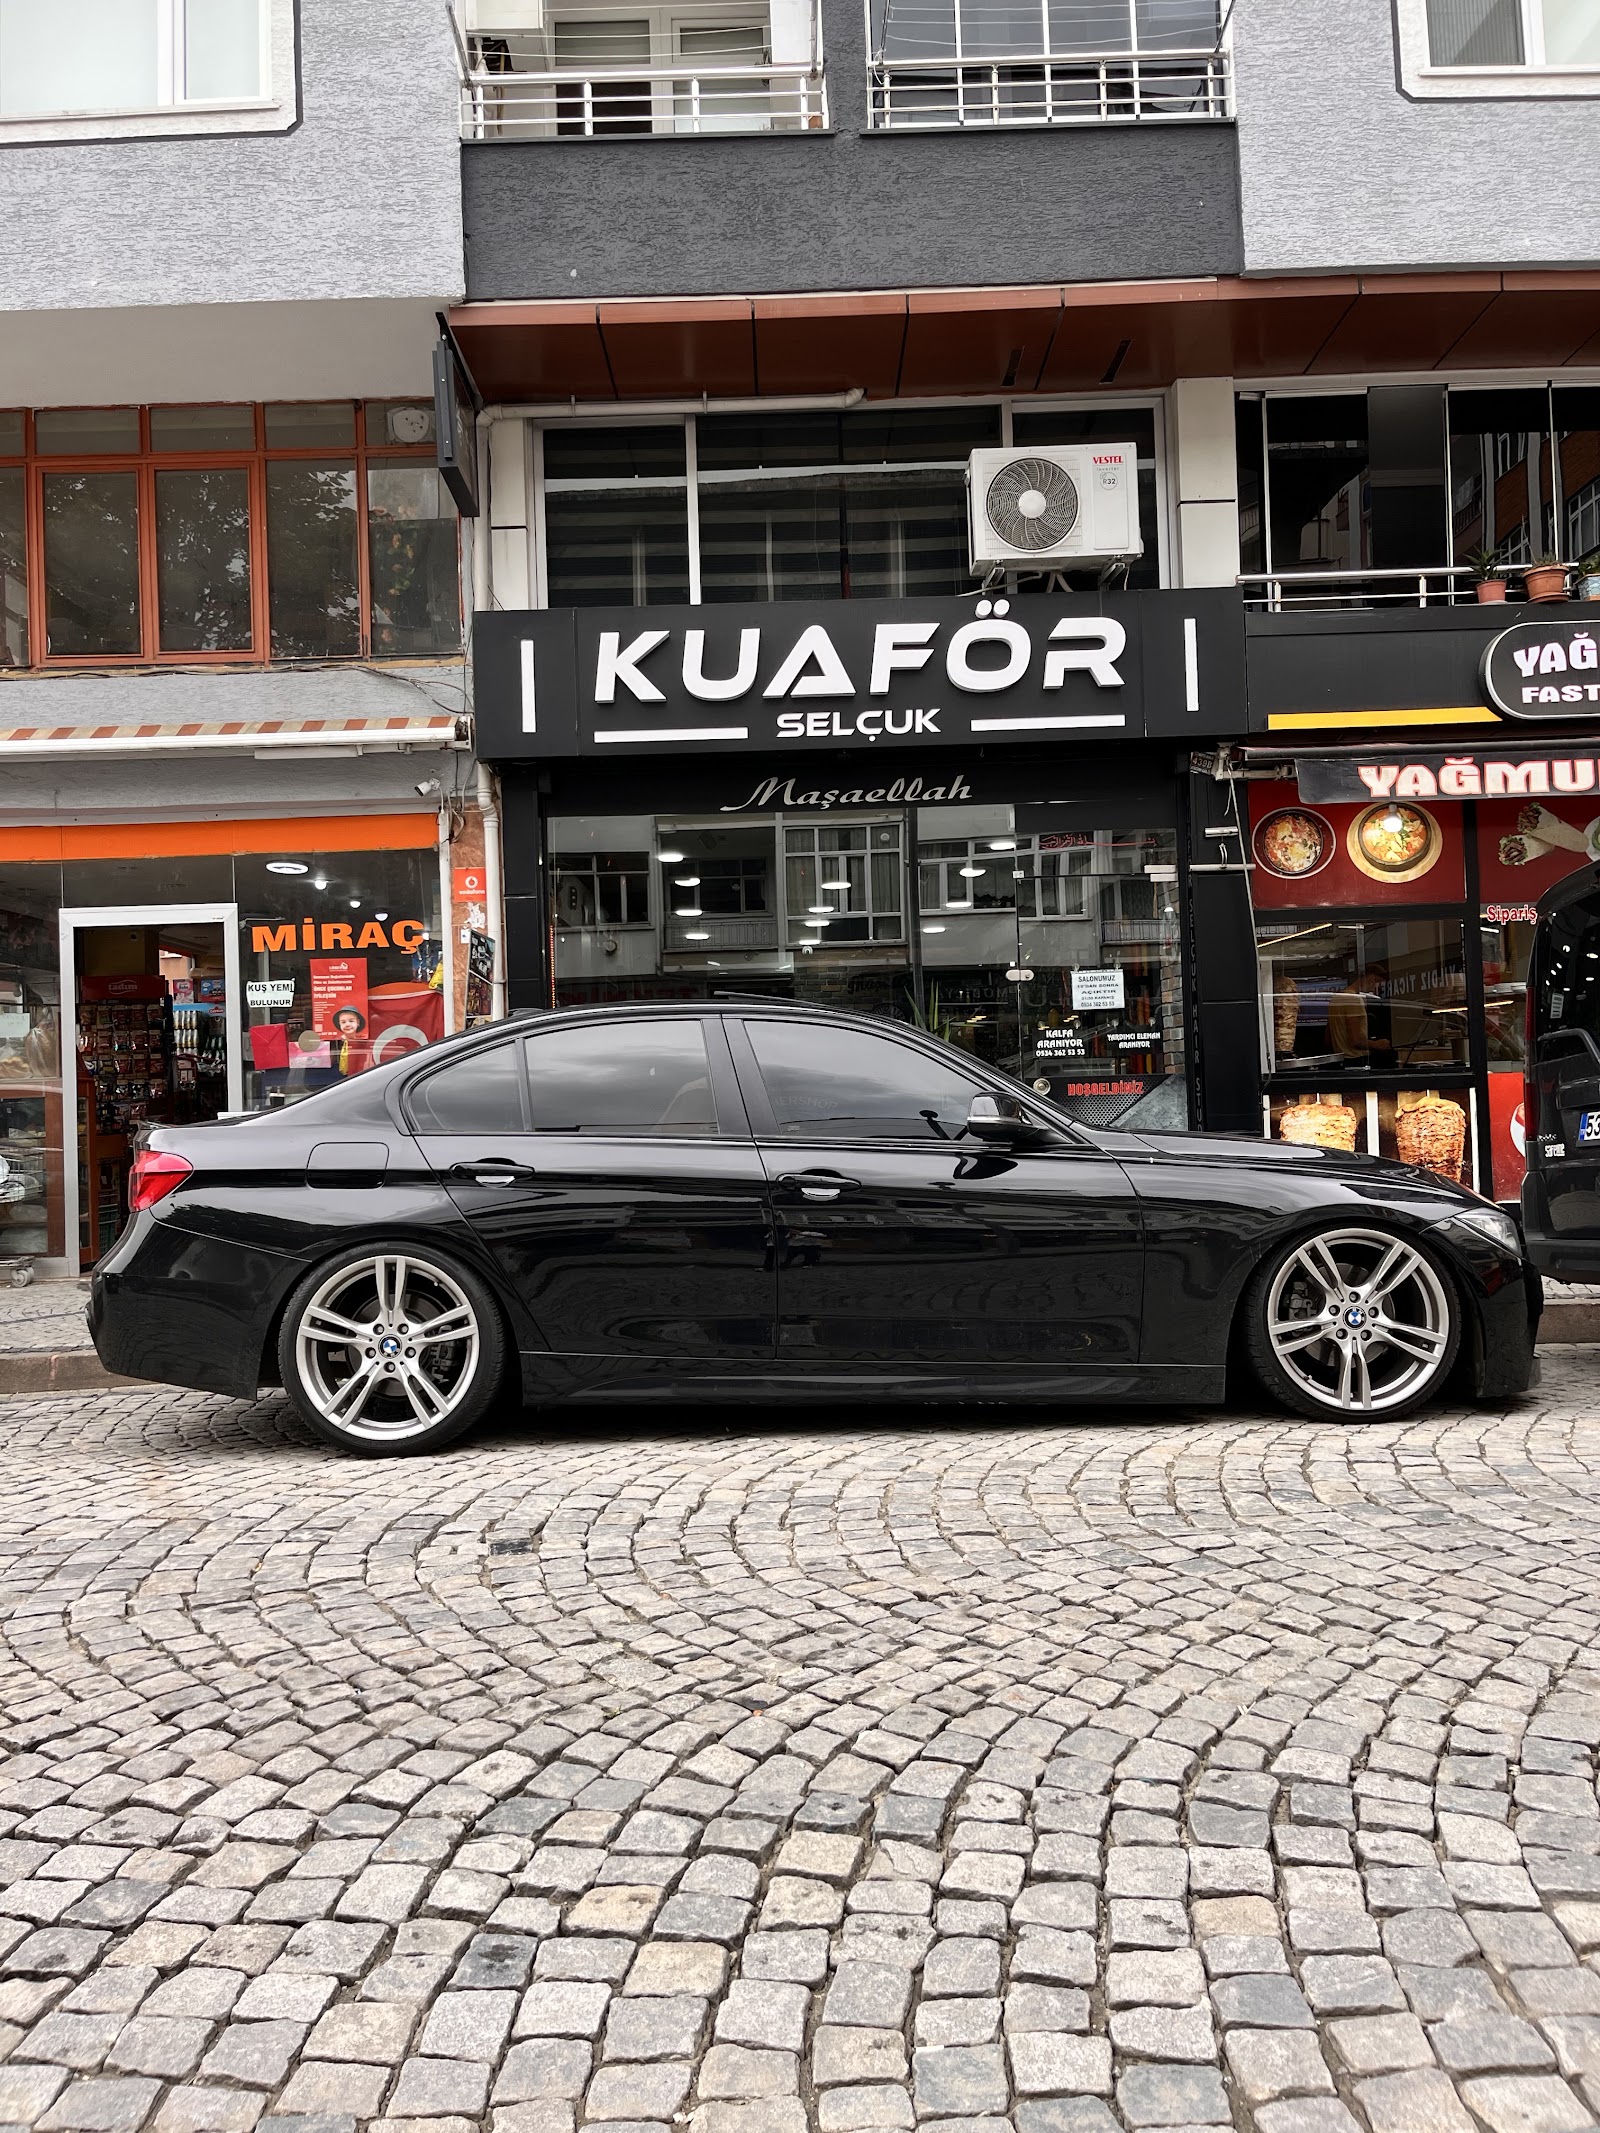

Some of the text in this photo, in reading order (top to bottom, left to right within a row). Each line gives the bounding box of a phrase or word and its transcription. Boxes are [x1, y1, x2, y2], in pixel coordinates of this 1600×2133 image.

[1093, 456, 1123, 464] VESTEL
[595, 599, 1126, 703] KUAFÖR
[1522, 685, 1600, 704] FAST
[776, 708, 941, 742] SELÇUK
[1358, 757, 1600, 797] YAĞMU
[720, 775, 972, 811] Maşaellah
[1486, 905, 1537, 925] Sipariş
[251, 917, 424, 955] MİRAÇ
[247, 984, 267, 992] KUŞ
[1045, 1029, 1074, 1038] KALFA
[1107, 1032, 1160, 1041] YARDIMCI ELEMAN
[1192, 1004, 1200, 1064] HAIR
[1036, 1039, 1083, 1049] ARANIYOR
[1076, 1048, 1086, 1056] 53
[1119, 1041, 1151, 1049] ARANIYOR
[1067, 1080, 1144, 1097] HOŞGELDİNİZ
